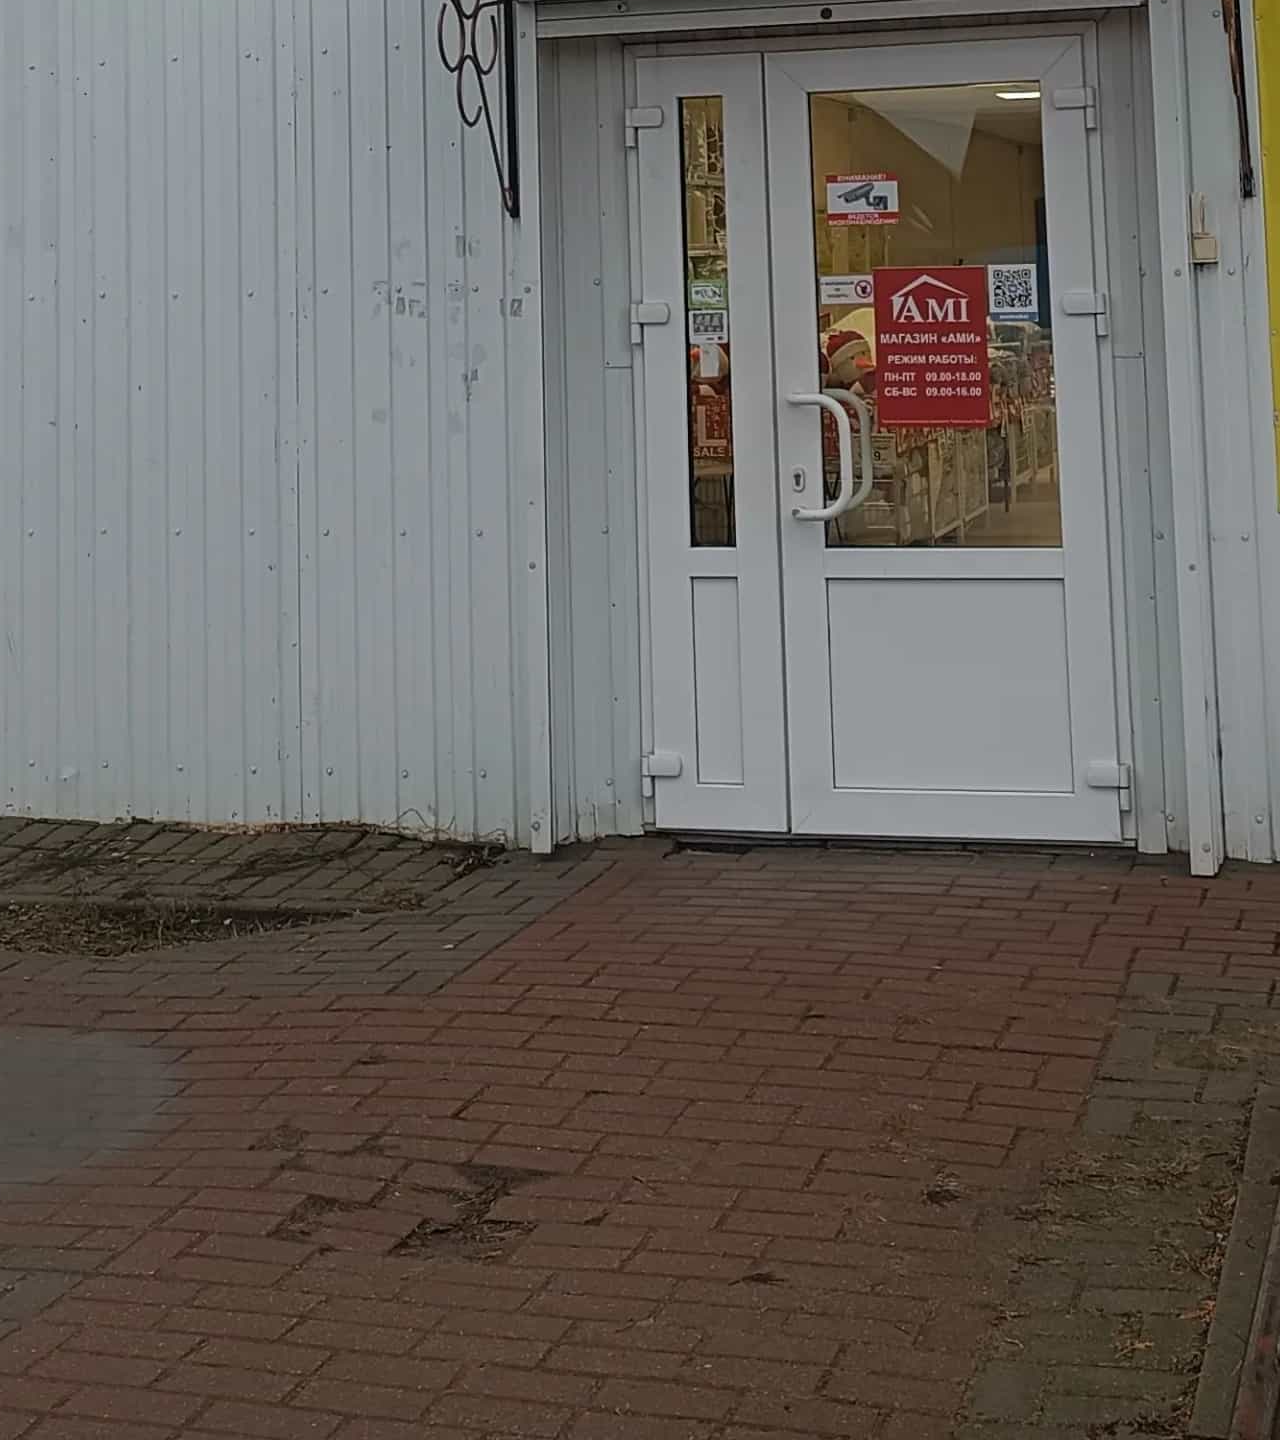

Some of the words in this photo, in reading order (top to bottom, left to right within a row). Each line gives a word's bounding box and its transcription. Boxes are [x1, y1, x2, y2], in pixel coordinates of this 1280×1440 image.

[896, 295, 971, 323] AMI
[880, 333, 938, 344] МАГАЗИН
[941, 332, 982, 344] «АМИ»
[887, 354, 927, 365] РЕЖИМ
[928, 354, 978, 365] РАБОТЫ:
[883, 371, 917, 382] ПН-ПТ
[884, 386, 918, 397] СБ-ВС
[693, 447, 727, 457] SALE
